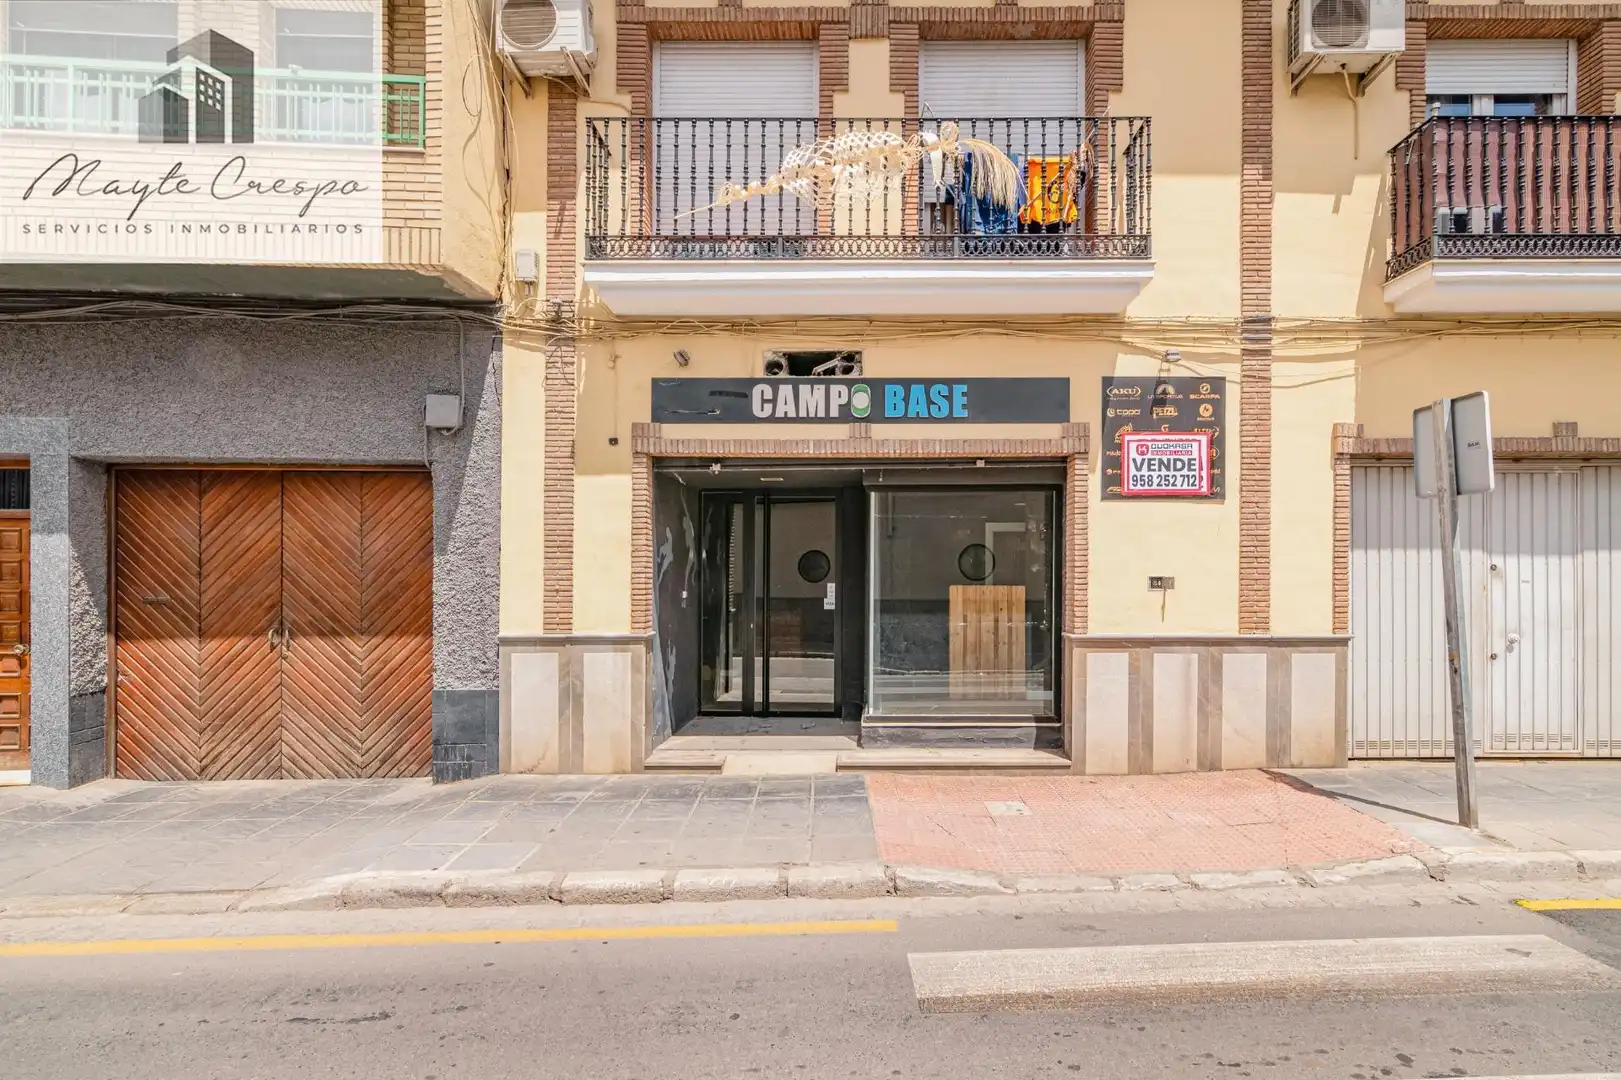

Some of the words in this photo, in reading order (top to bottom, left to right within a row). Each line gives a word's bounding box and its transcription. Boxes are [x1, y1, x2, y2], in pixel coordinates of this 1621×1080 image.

[884, 384, 969, 418] BASE
[1152, 406, 1178, 419] PETZL
[1132, 458, 1197, 472] VENDE
[1132, 474, 1154, 487] 958
[1156, 474, 1178, 487] 252
[1180, 474, 1197, 487] 712
